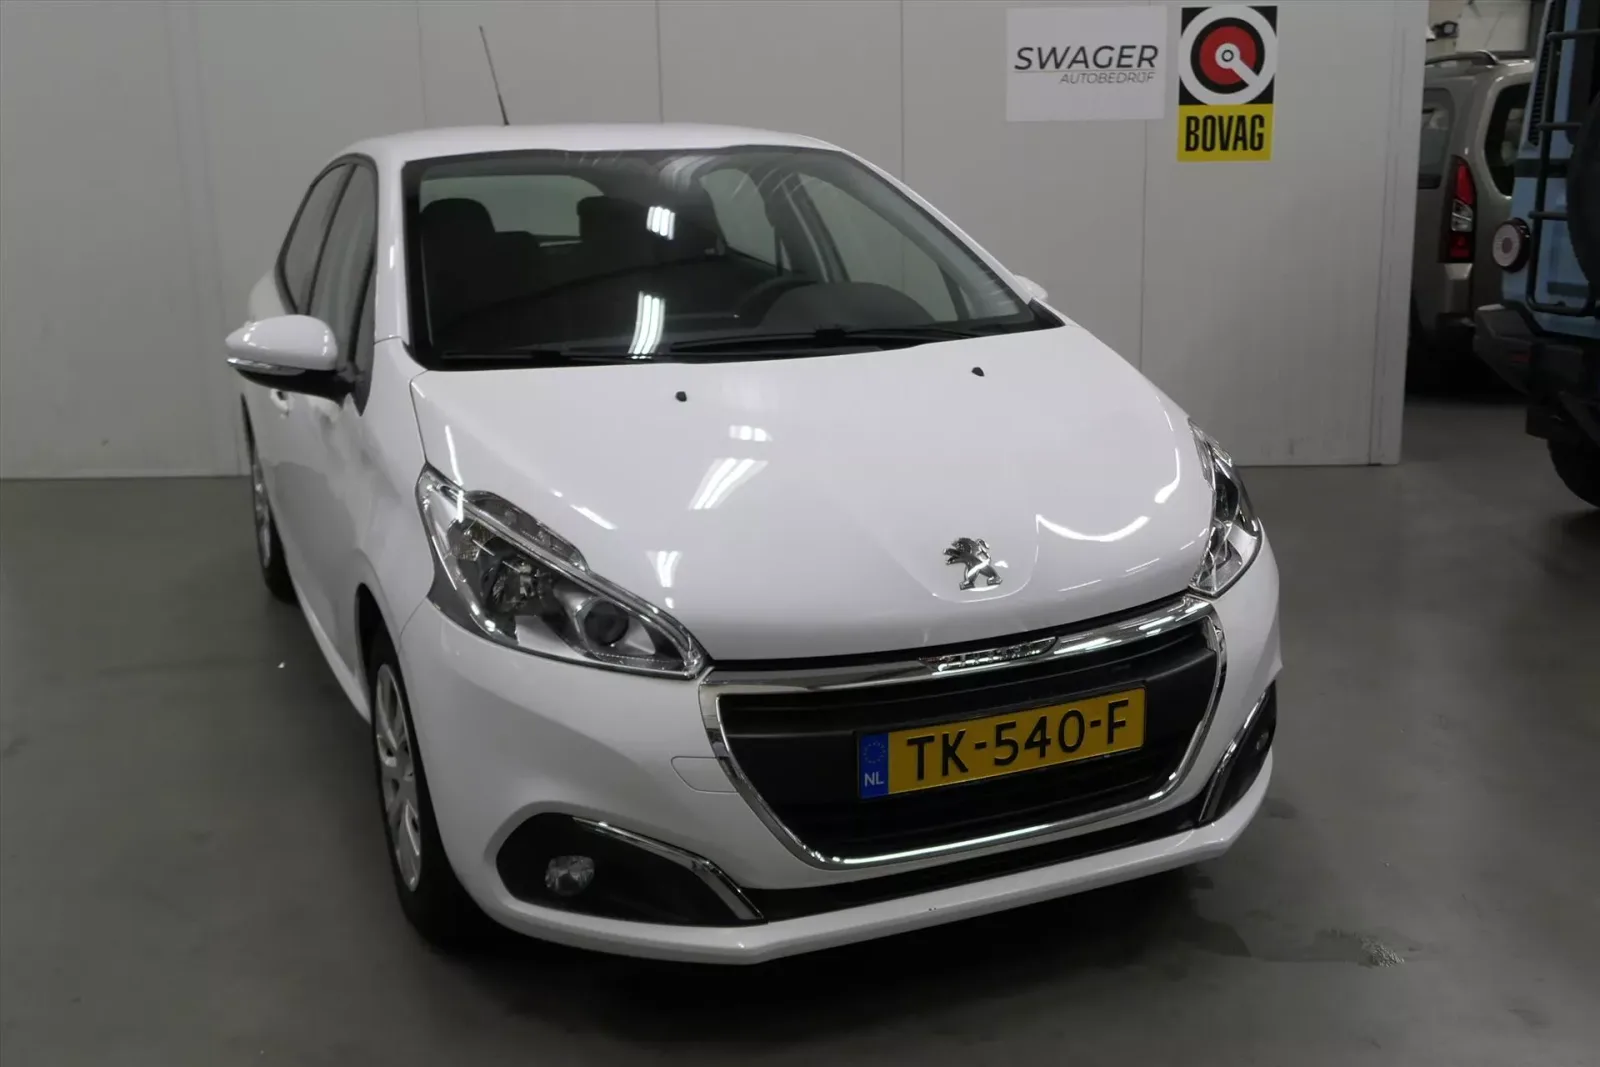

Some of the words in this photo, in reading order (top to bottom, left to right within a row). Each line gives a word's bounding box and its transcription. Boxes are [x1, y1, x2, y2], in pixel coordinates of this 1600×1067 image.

[1014, 45, 1158, 70] SWAGER
[1060, 72, 1155, 84] AUTOBEDRIJF
[1185, 114, 1265, 152] BOVAG
[906, 699, 1129, 781] TK-540-F
[864, 771, 885, 788] NL
